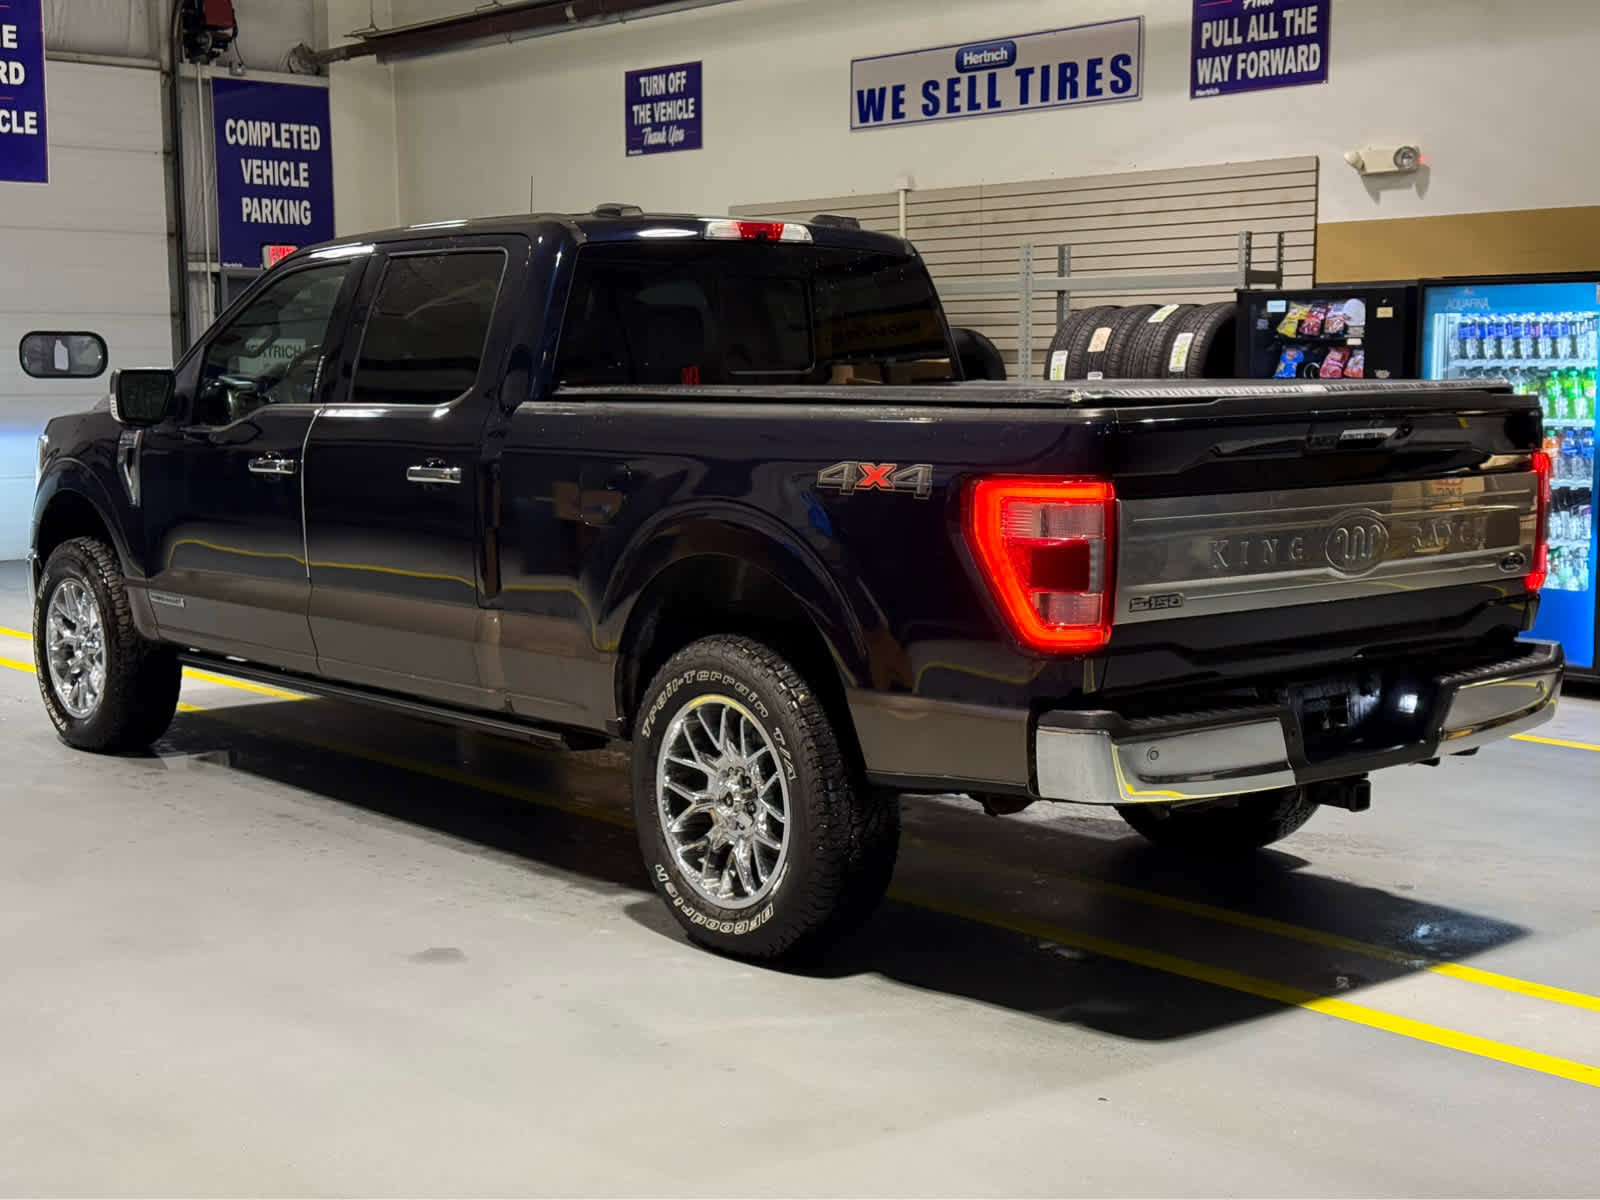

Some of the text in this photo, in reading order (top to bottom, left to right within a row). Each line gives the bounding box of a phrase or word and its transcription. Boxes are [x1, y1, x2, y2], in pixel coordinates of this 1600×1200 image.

[1201, 5, 1318, 49] PULL ALL THE
[962, 47, 1009, 67] Hertrich
[1196, 43, 1321, 85] WAY FORWARD
[639, 71, 687, 97] TURN OFF
[856, 53, 1133, 124] WE SELL TIRES
[632, 97, 695, 125] THE VEHICLE
[225, 118, 321, 151] COMPLETED
[642, 124, 685, 146] Thank You
[240, 158, 310, 188] VEHICLE
[241, 197, 312, 225] PARKING
[1207, 537, 1304, 568] KING
[641, 670, 769, 737] Trail-Terrain
[655, 864, 774, 936] BFGoodrich
